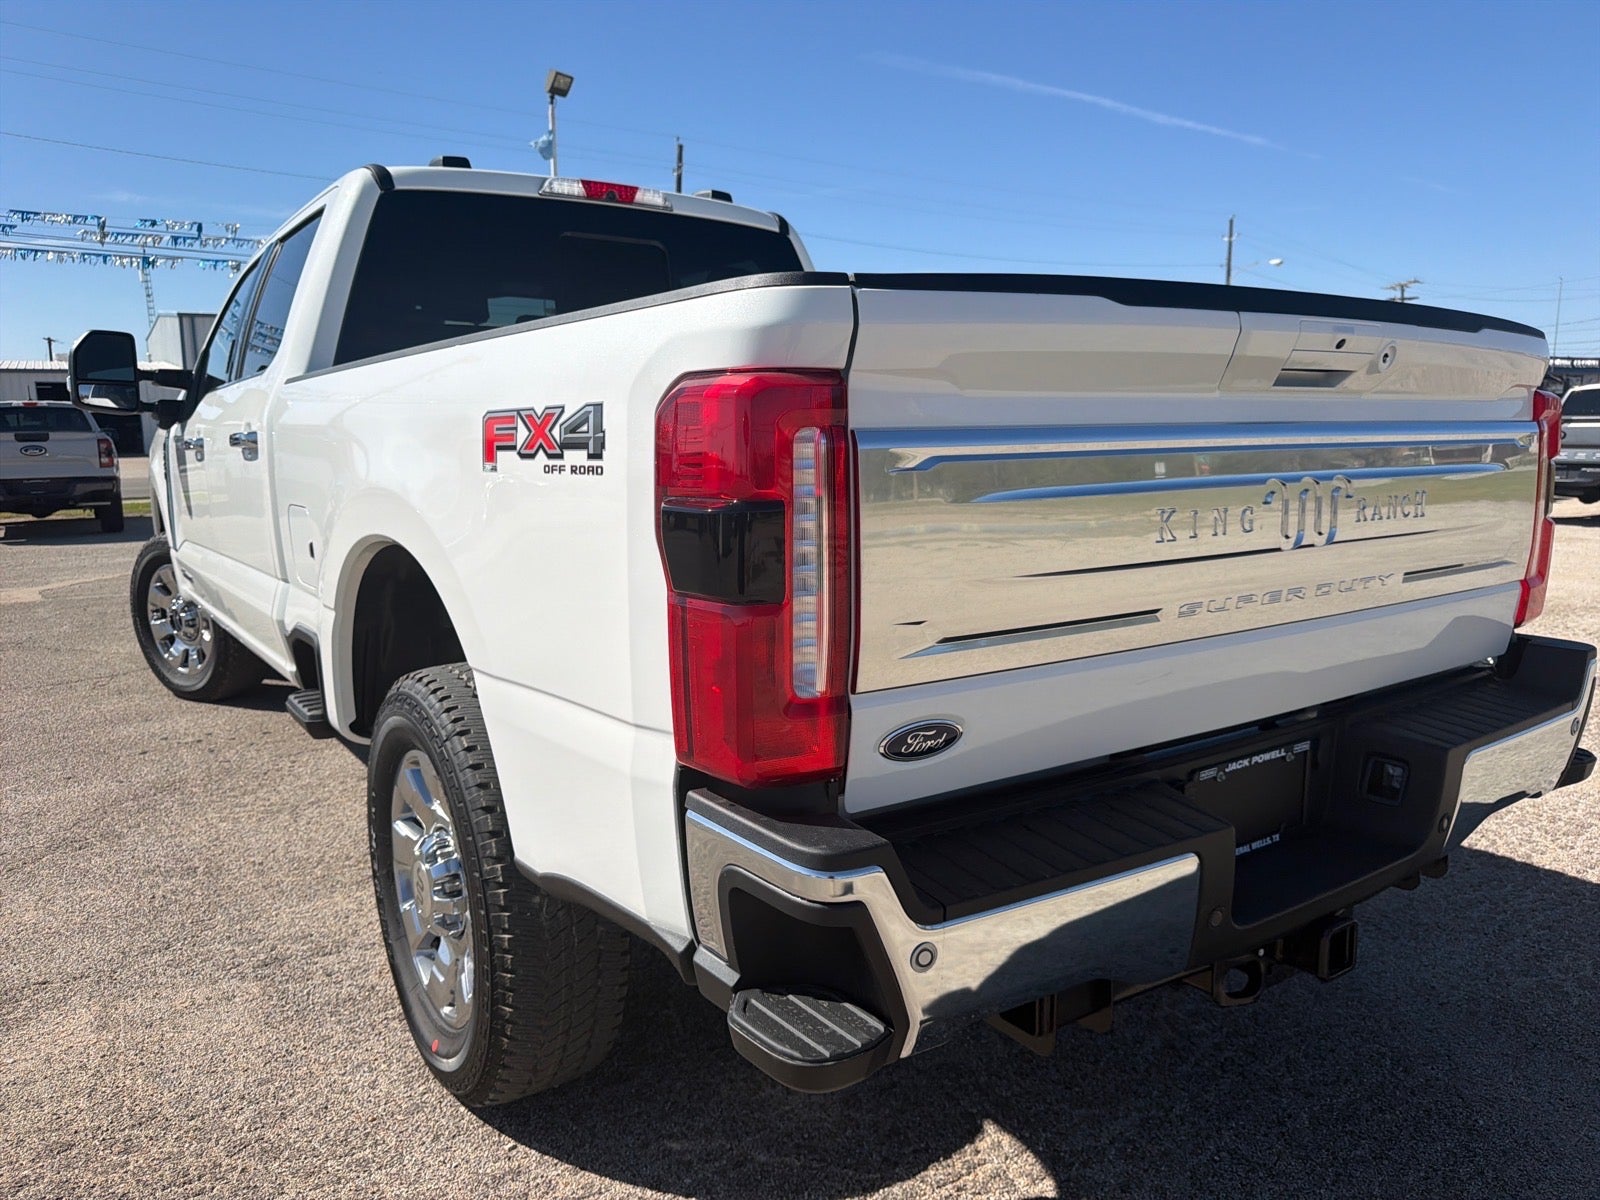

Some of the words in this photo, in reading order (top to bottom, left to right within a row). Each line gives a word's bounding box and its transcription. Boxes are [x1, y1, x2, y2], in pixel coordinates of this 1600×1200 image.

[482, 401, 605, 472] FX4
[543, 464, 566, 475] OFF
[570, 465, 604, 476] ROAD
[1155, 505, 1254, 543] KING
[1355, 489, 1427, 523] RANCH
[1177, 586, 1307, 618] SUPER
[1314, 573, 1395, 597] DUTY
[901, 730, 947, 753] Ford
[1225, 759, 1250, 772] JACK
[1251, 749, 1286, 764] POWELL
